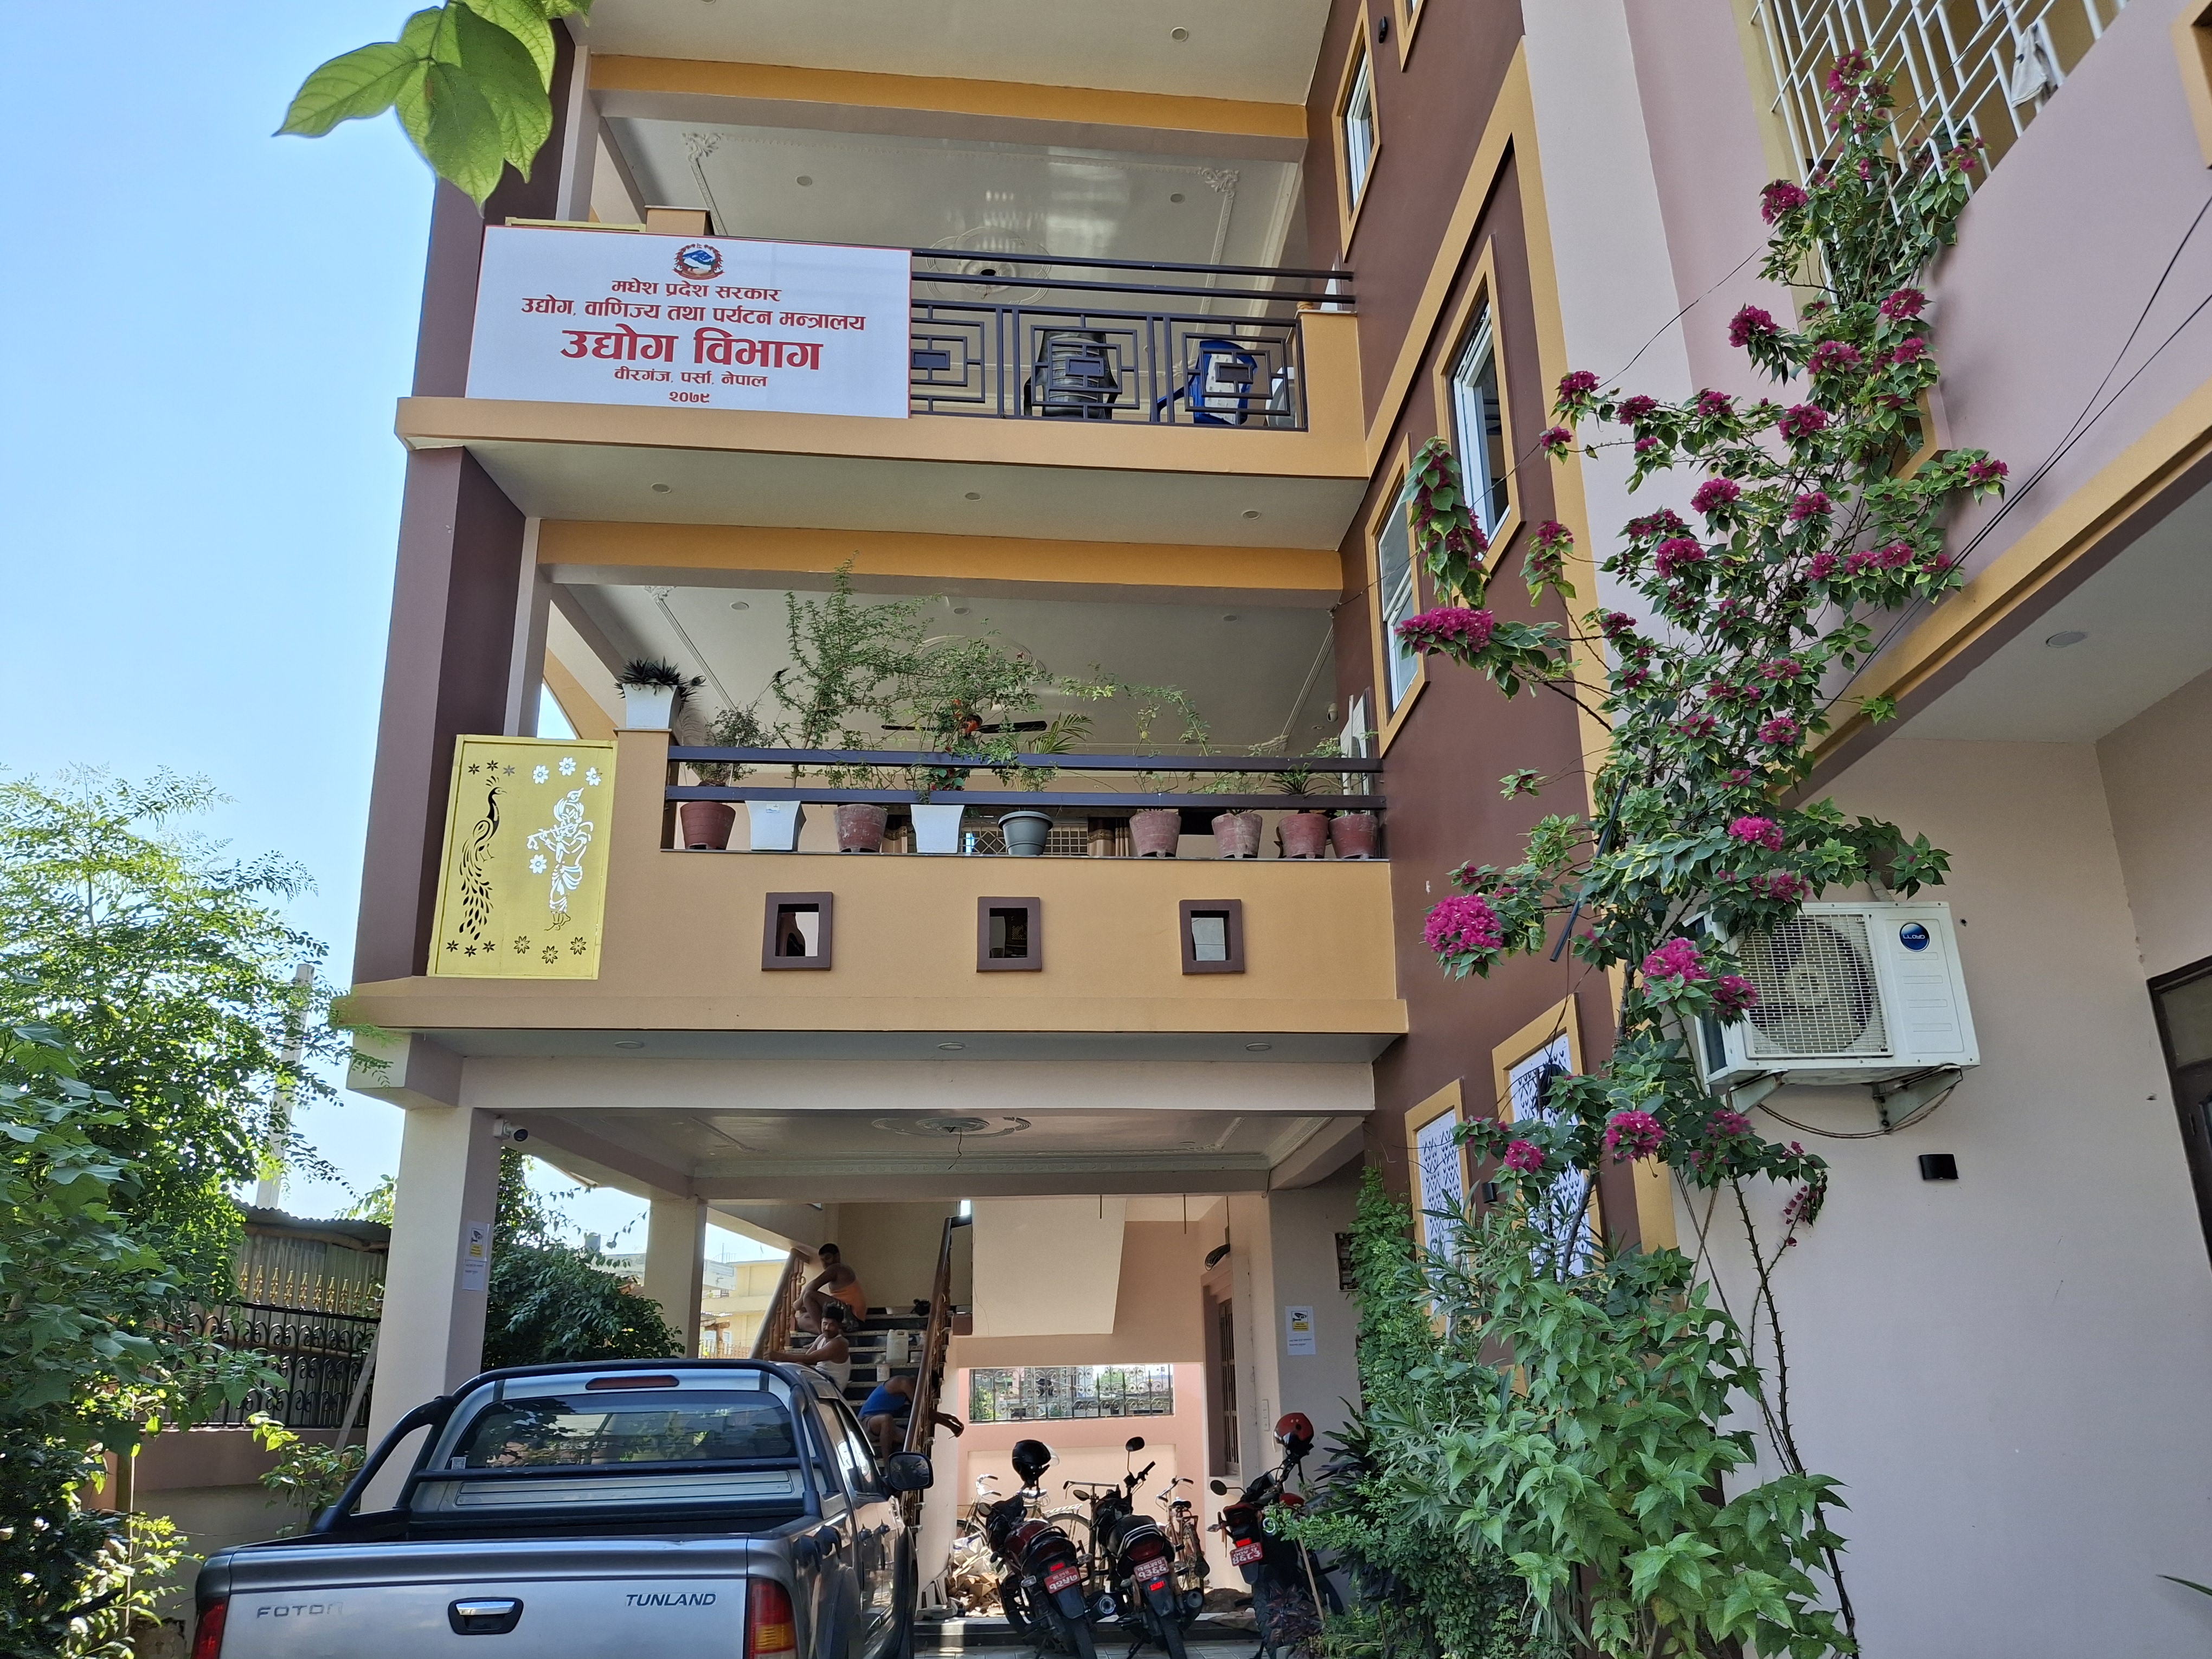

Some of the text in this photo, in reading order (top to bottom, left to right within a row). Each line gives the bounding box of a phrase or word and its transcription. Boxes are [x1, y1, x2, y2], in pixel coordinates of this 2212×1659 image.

[665, 280, 709, 298] प्रदेश
[715, 286, 782, 302] सरकार
[521, 294, 866, 331] उद्योग, वाणिज्य तथा पर्यटन मन्त्रालय
[560, 323, 824, 370] उद्योग विभाग
[614, 365, 768, 387] वीरगंज, पर्सा, नेपाल
[668, 391, 710, 403] २०७९
[1232, 1550, 1261, 1565] ४६८३
[1138, 1564, 1167, 1578] १३६६
[1049, 1574, 1078, 1590] १२५७
[626, 1593, 716, 1606] TUNLAND
